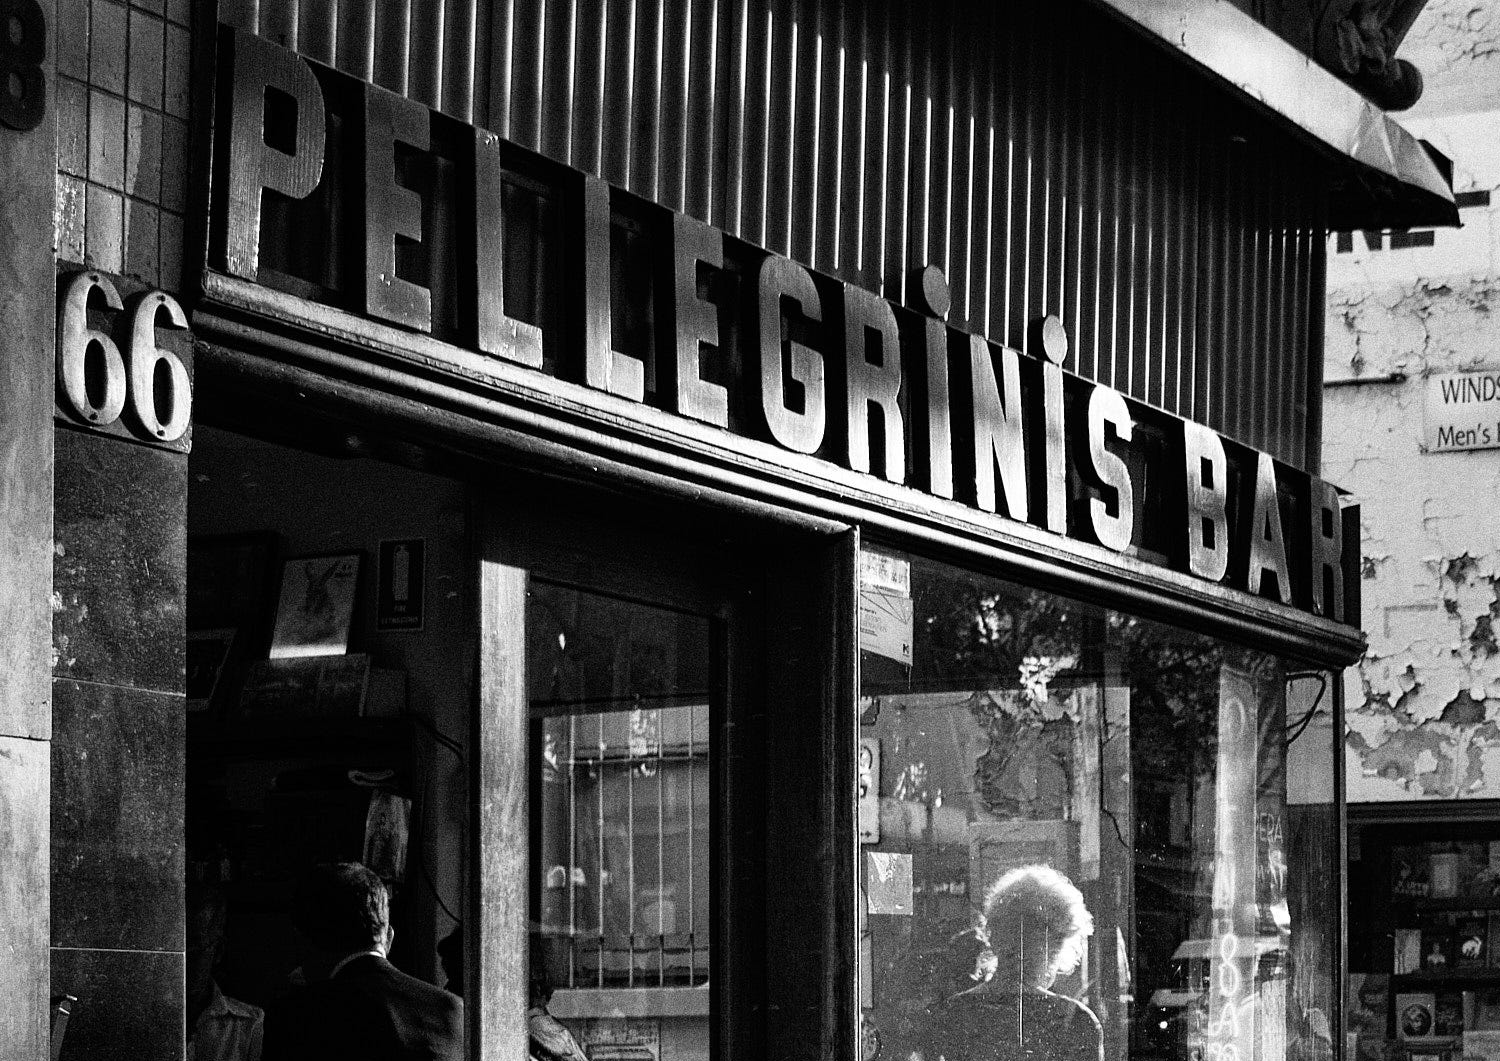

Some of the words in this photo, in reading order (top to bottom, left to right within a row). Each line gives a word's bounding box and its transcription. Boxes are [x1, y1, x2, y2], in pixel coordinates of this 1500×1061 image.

[59, 271, 192, 441] 66
[1437, 423, 1491, 448] Men's
[1184, 418, 1344, 622] BAR
